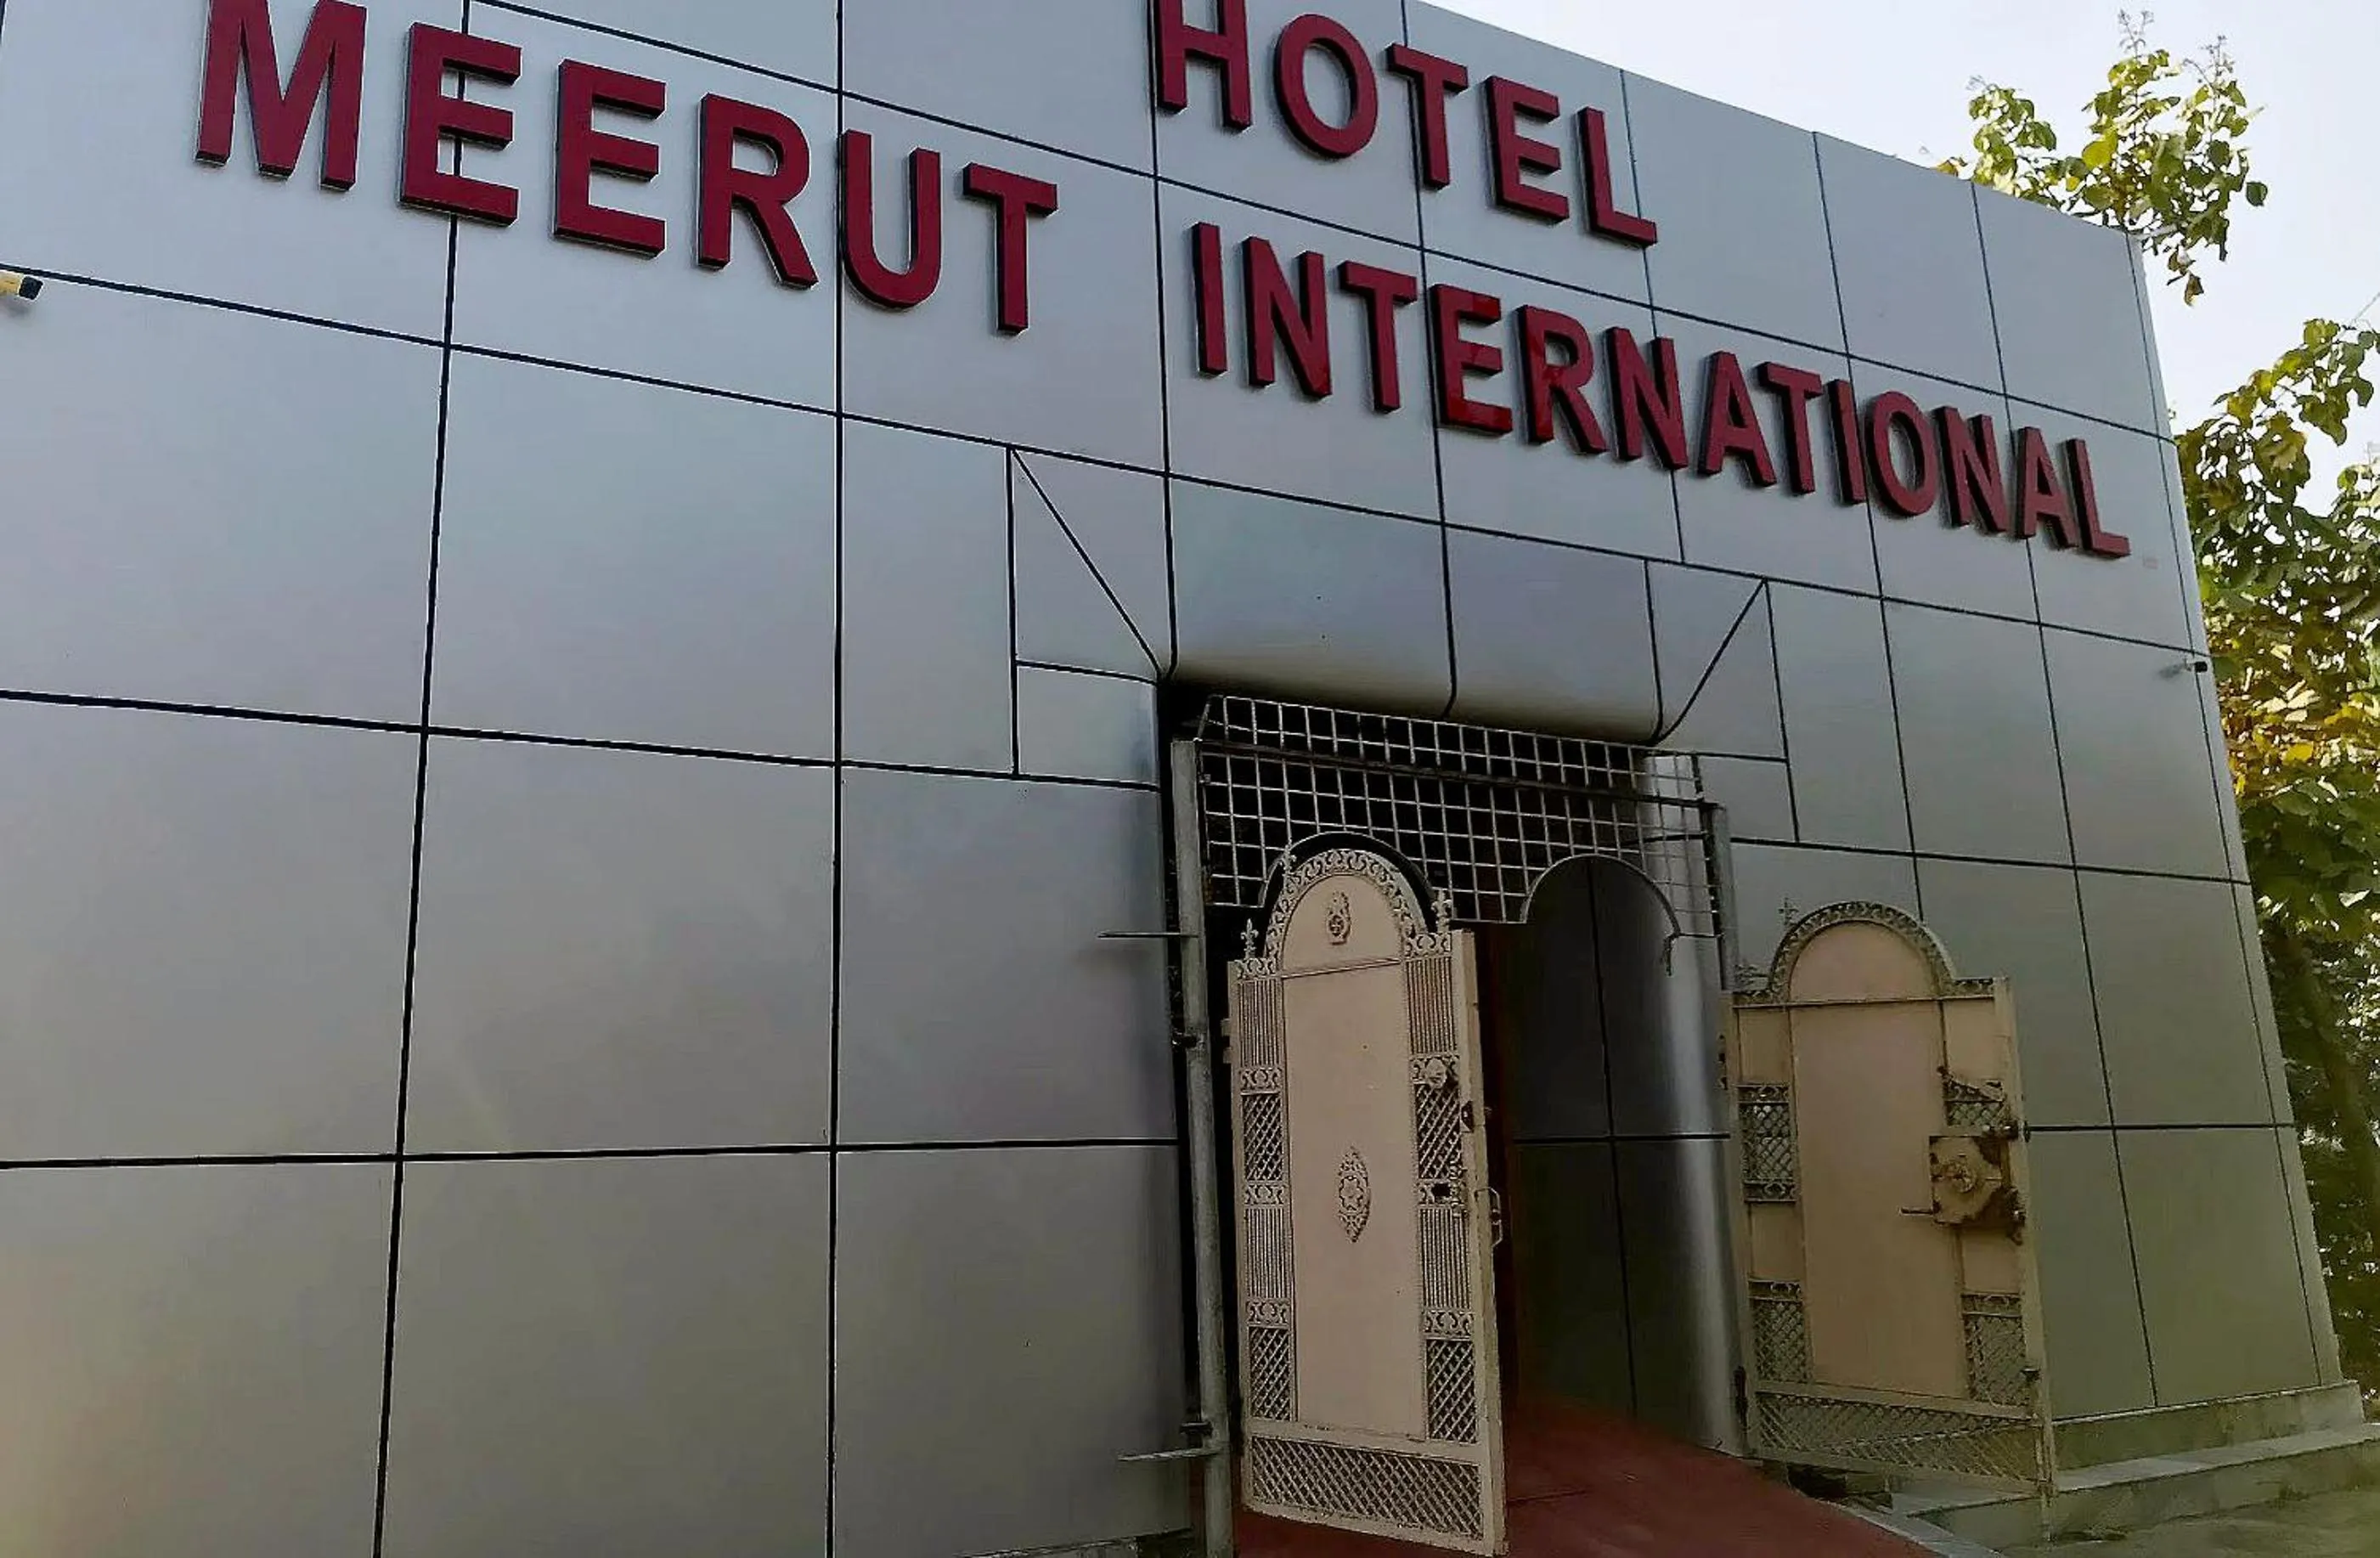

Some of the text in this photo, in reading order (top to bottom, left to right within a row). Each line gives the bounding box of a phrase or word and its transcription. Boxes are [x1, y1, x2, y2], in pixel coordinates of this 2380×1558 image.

[195, 0, 2130, 558] MEERUT INTERNATIONAL
[1157, 0, 1656, 247] HOTEL
